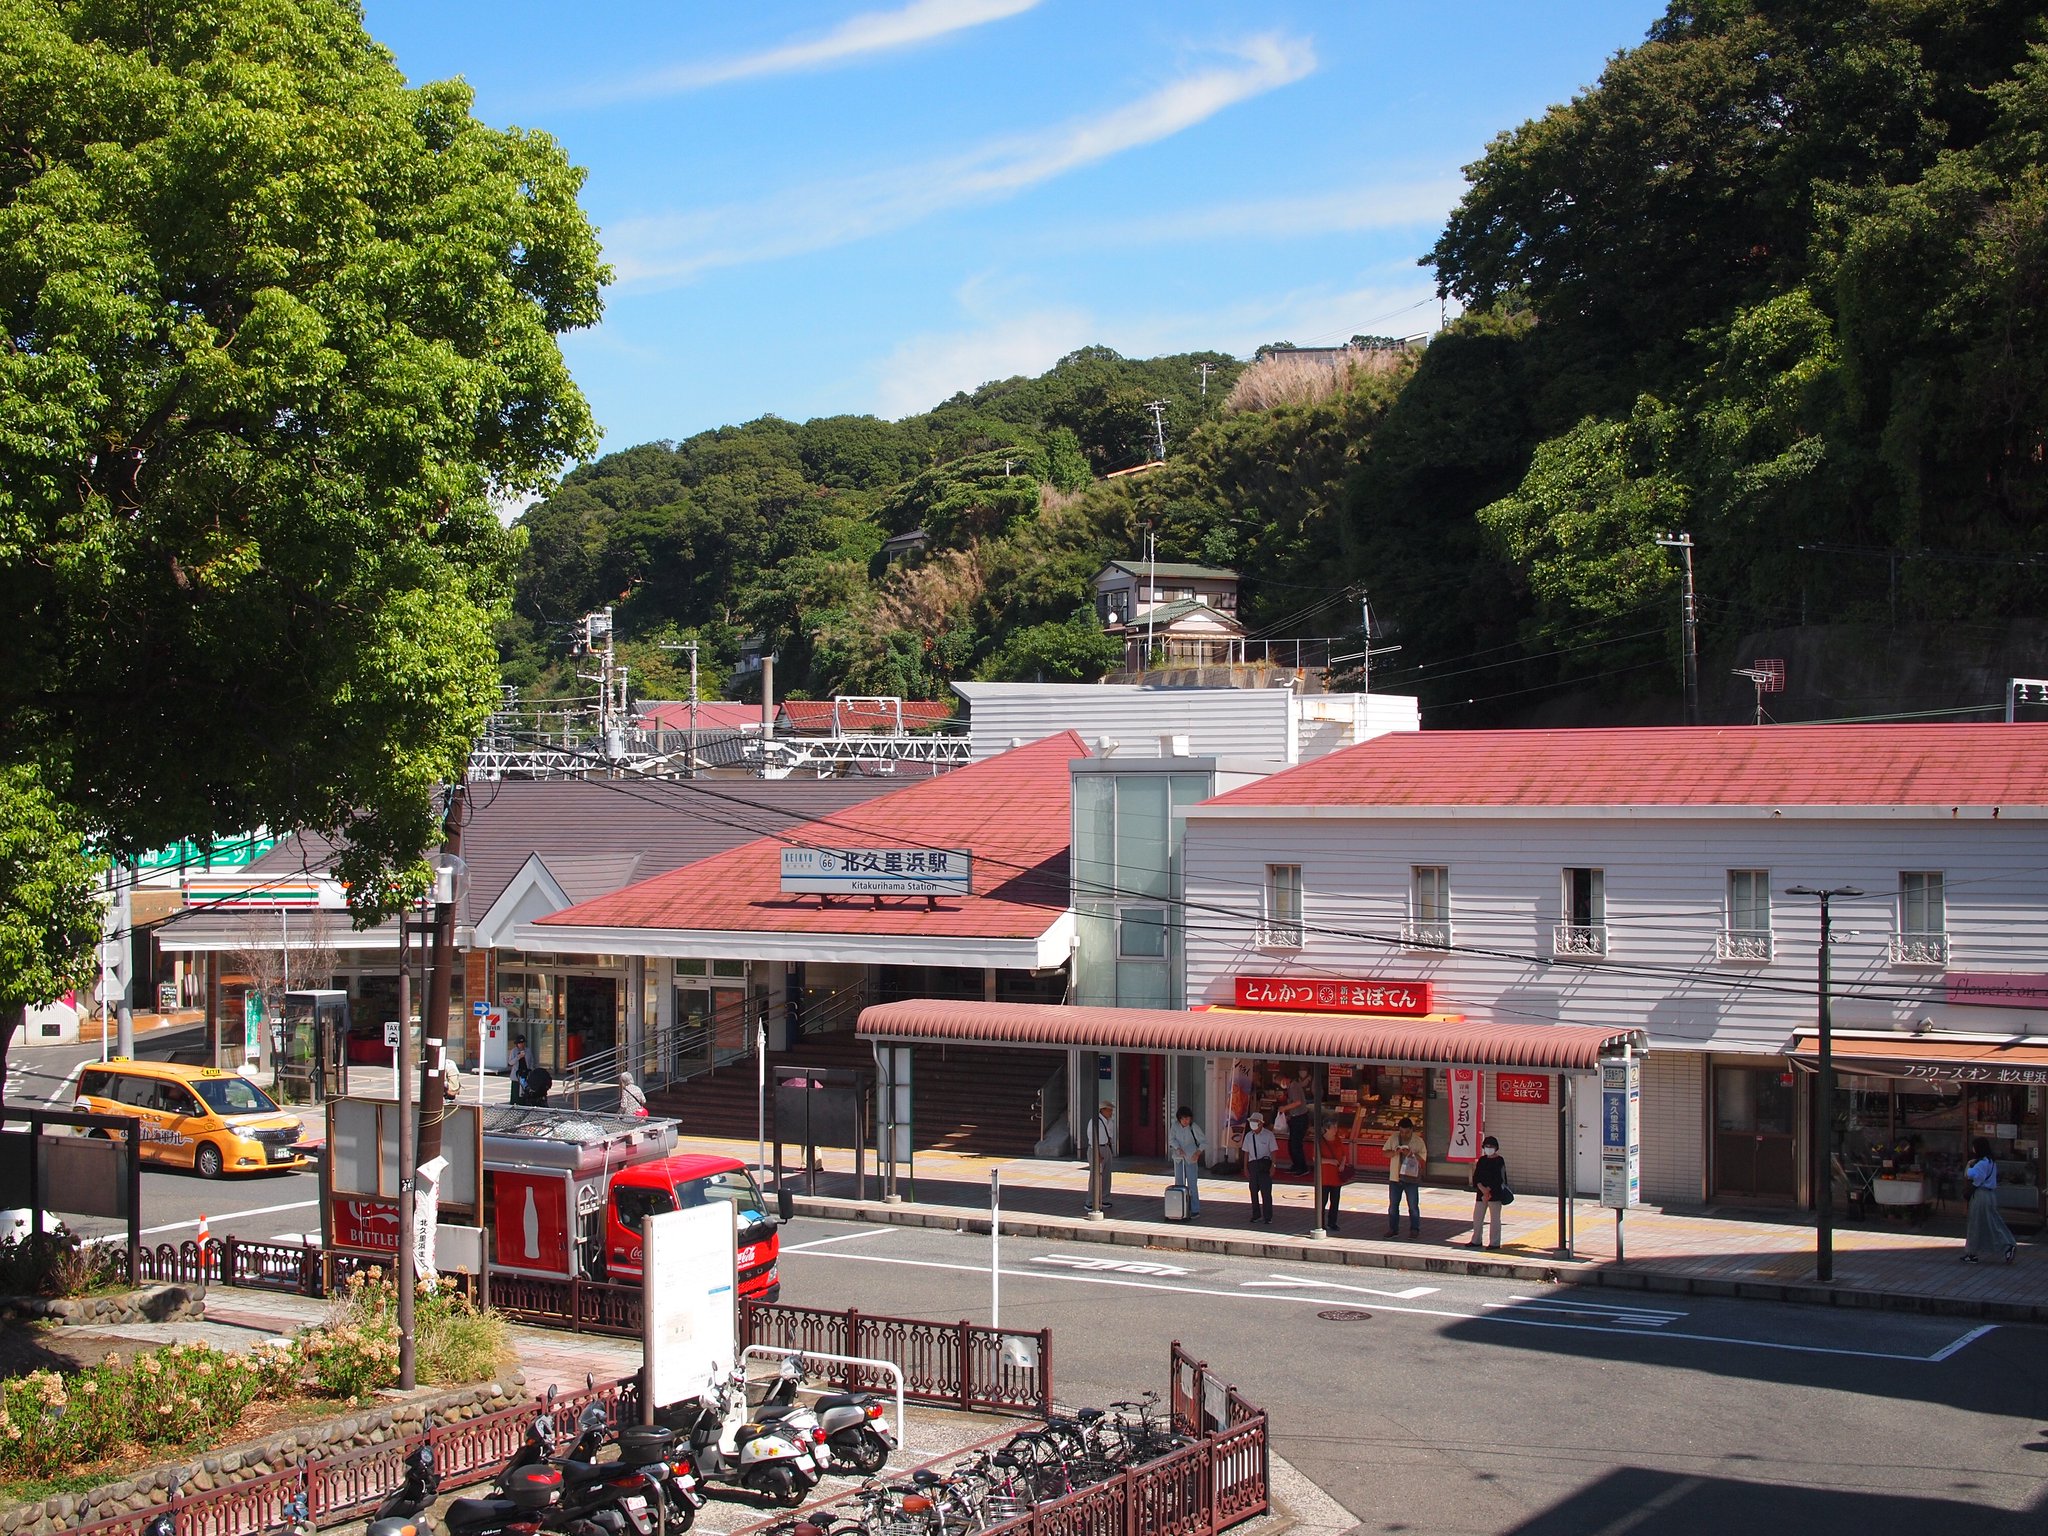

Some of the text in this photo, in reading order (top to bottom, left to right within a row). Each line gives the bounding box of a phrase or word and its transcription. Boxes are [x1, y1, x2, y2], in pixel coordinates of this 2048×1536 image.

[785, 853, 812, 862] KEIKYU
[822, 859, 833, 868] 66
[841, 851, 948, 873] 北久里浜駅
[851, 881, 937, 892] Kitakurihama Station
[1245, 983, 1314, 1003] とんかつ
[1351, 986, 1417, 1008] さぼてん
[1998, 1069, 2048, 1085] 北久里浜
[1512, 1079, 1543, 1089] とんかつ
[1513, 1089, 1542, 1099] さぼてん
[1610, 1097, 1618, 1142] 北久里浜駅
